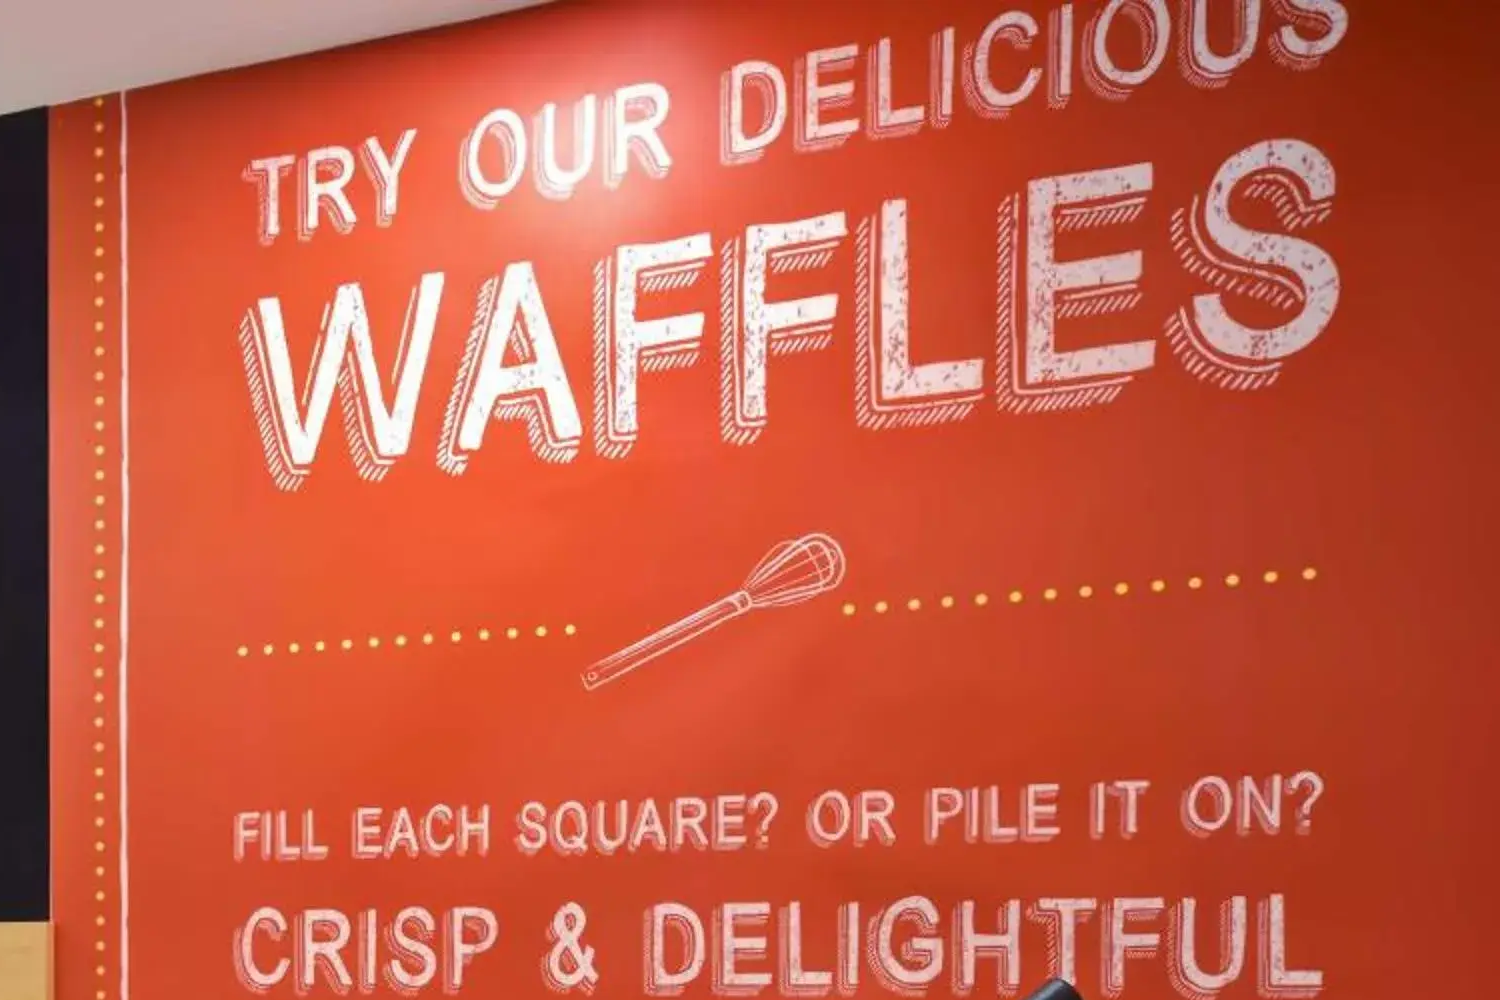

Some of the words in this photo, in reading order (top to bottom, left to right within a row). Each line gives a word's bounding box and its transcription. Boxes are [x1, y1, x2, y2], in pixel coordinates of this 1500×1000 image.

[241, 128, 417, 245] TRY
[459, 82, 672, 210] OUR
[720, 0, 1348, 165] DELICIOUS
[240, 138, 1342, 492] WAFFLES
[234, 810, 329, 862] FILL
[351, 803, 490, 858] EACH
[515, 791, 779, 852] SQUARE?
[805, 789, 896, 848] OR
[925, 783, 1060, 845] PILE
[1090, 780, 1150, 839] IT
[1181, 771, 1324, 837] ON?
[233, 906, 498, 996] CRISP
[541, 900, 599, 996] &
